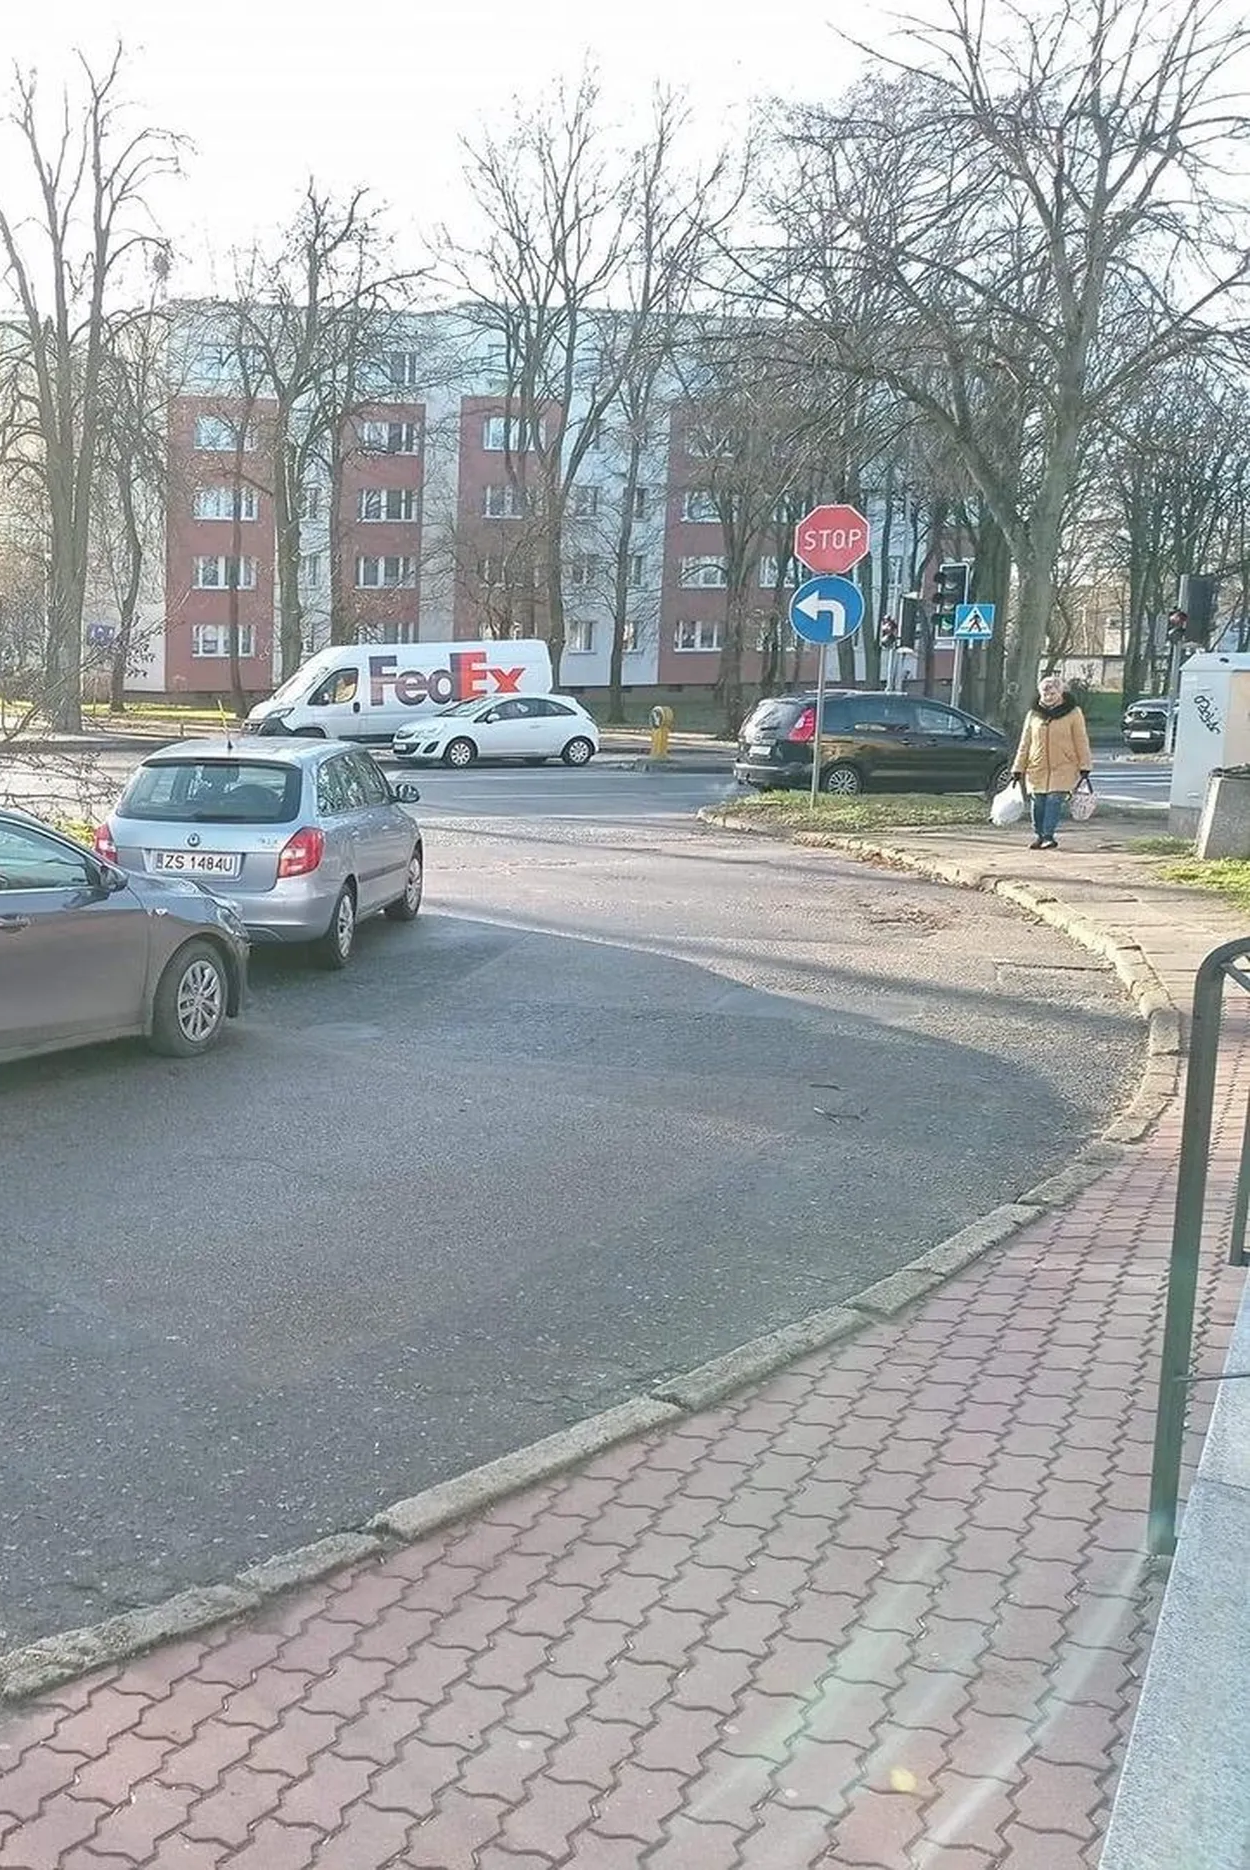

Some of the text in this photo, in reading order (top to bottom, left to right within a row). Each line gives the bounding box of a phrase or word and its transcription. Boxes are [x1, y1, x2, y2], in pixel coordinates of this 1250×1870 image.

[804, 529, 862, 551] STOP
[368, 651, 527, 707] FedEx
[164, 854, 233, 872] ZS 1484U
